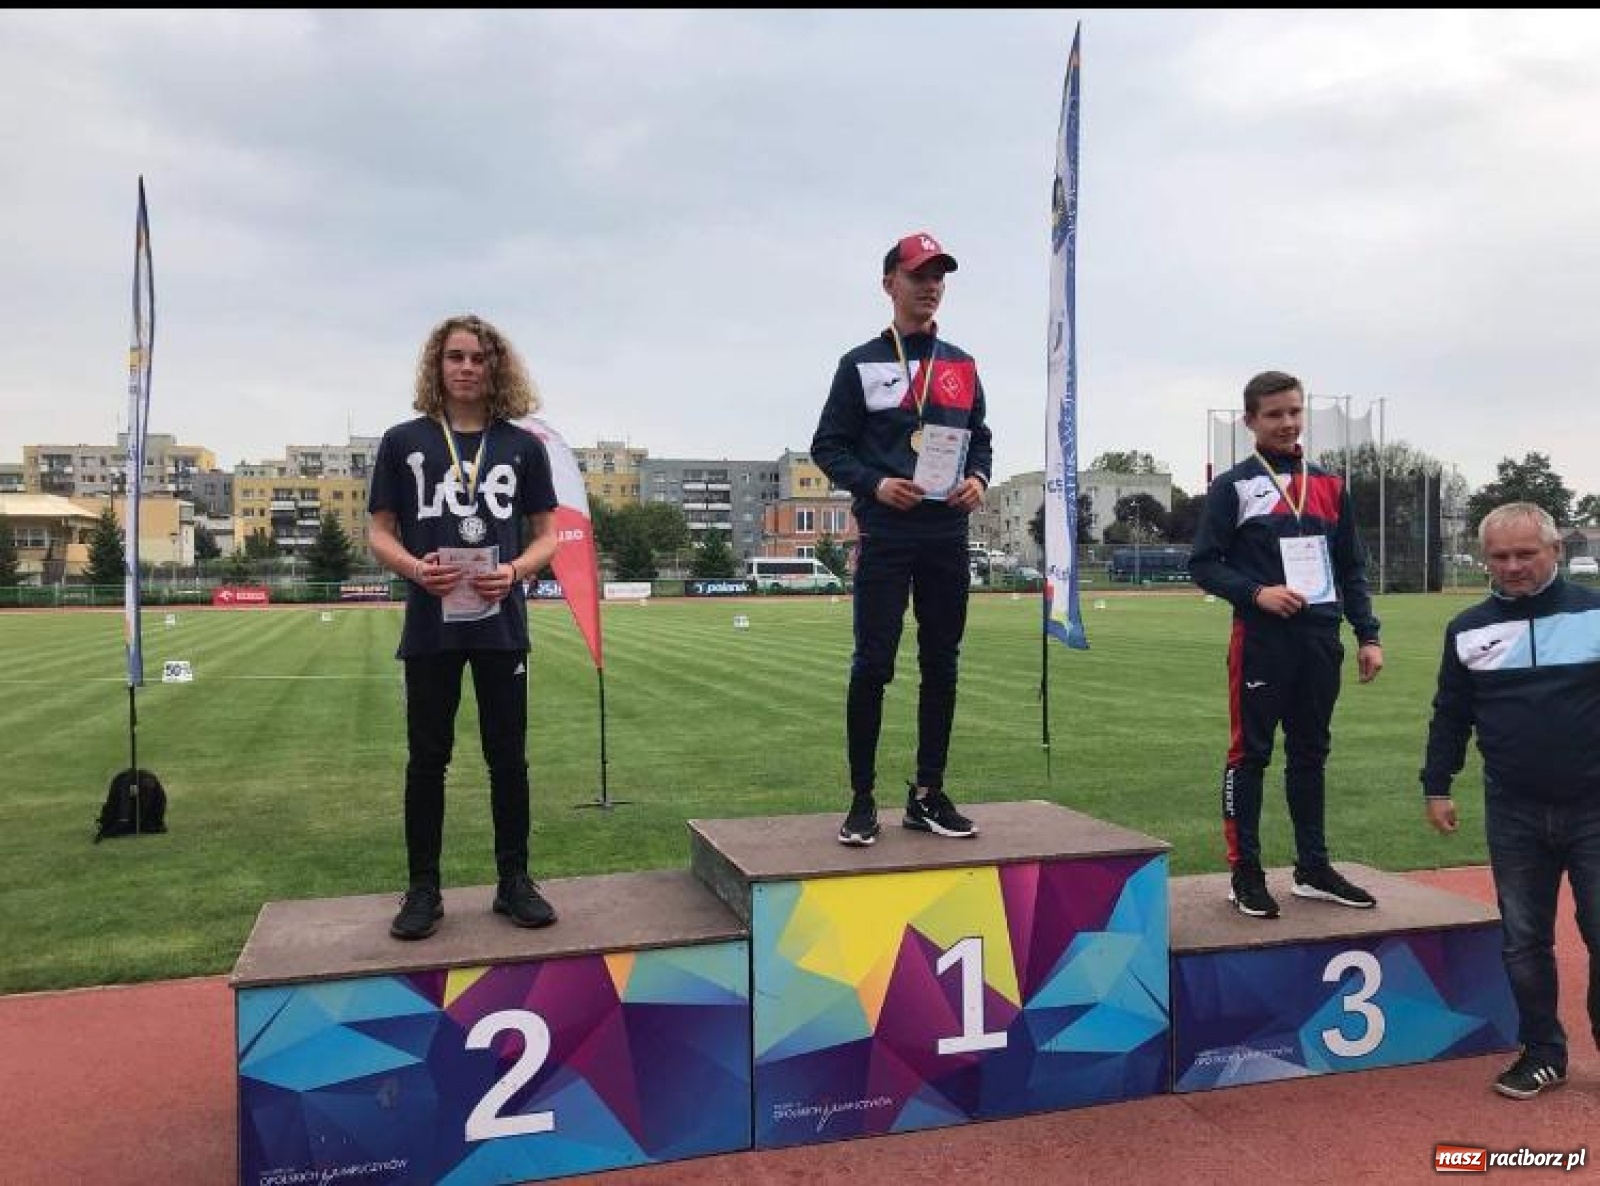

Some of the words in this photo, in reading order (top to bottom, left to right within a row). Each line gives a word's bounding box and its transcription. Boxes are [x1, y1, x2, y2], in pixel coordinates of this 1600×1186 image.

[406, 451, 518, 521] Lee
[936, 936, 1008, 1055] 1
[1321, 949, 1386, 1058] 3
[464, 1007, 556, 1142] 2
